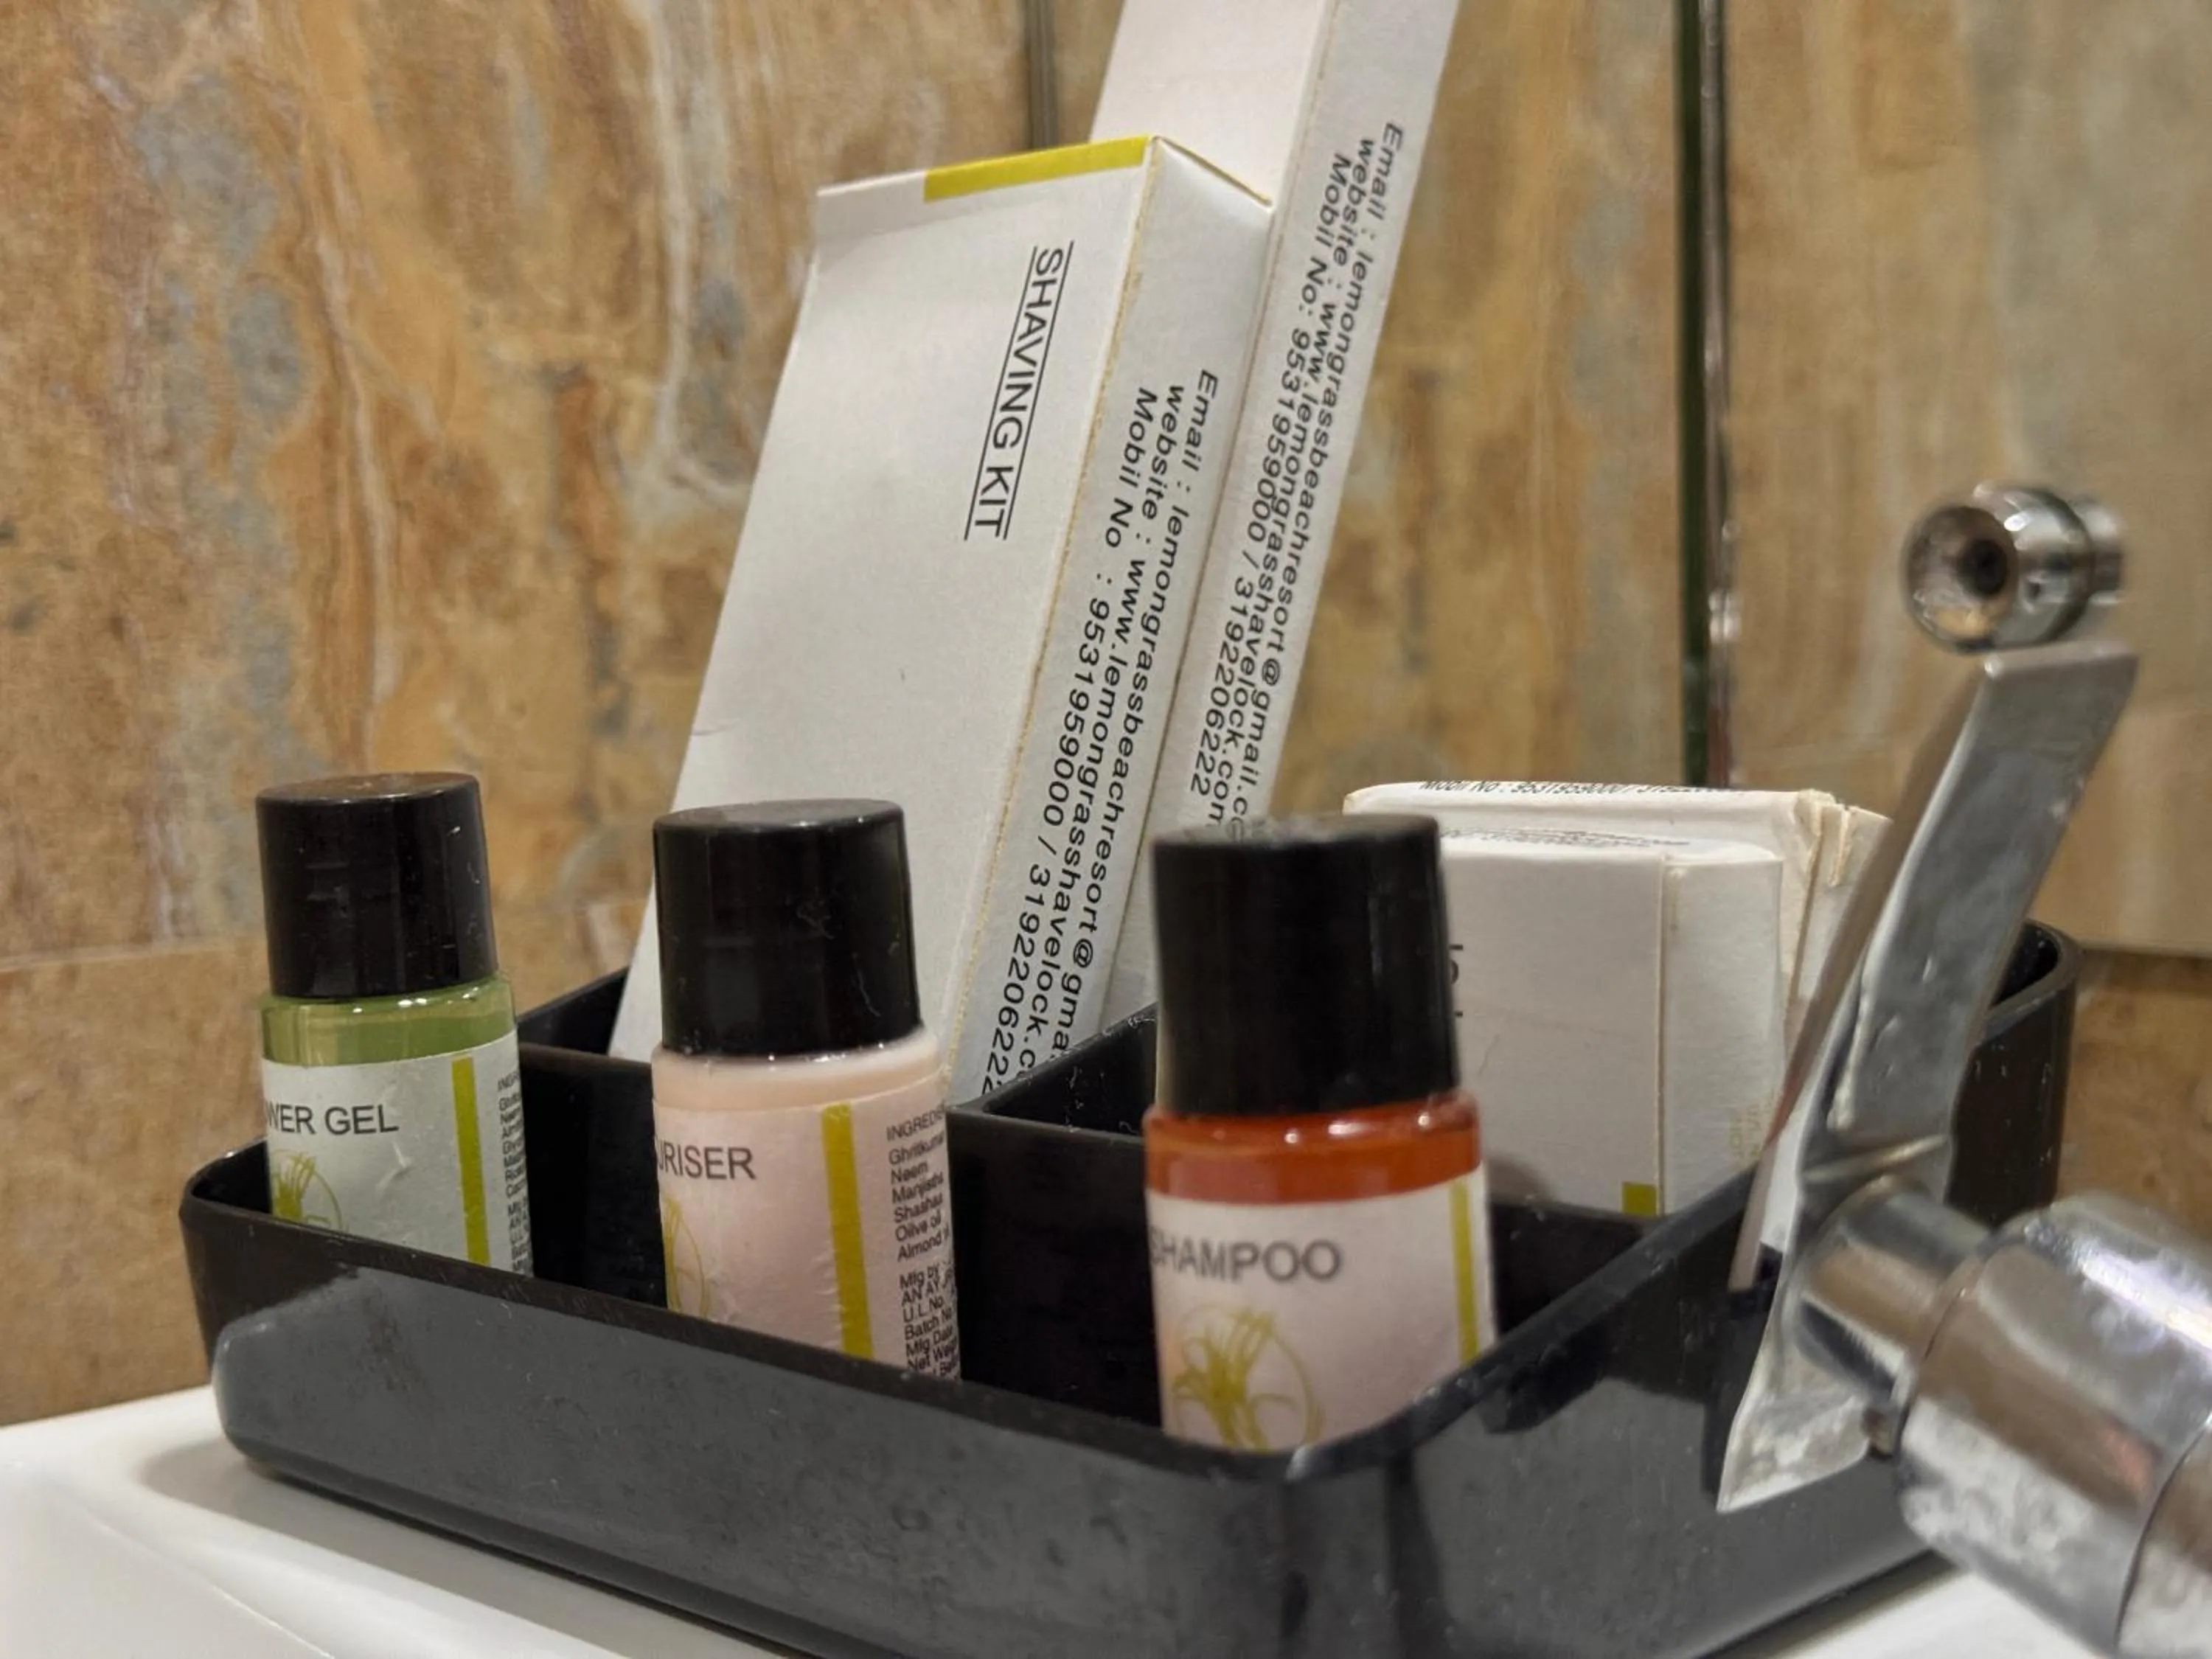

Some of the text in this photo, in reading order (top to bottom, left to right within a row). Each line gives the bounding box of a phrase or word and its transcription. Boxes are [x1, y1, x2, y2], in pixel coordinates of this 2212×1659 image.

[1315, 153, 1352, 248] Mobil
[1333, 139, 1374, 267] website
[1367, 122, 1404, 221] Email
[975, 247, 1062, 538] SHAVING KIT
[1119, 387, 1158, 488] Mobil
[1141, 385, 1184, 520] website
[1182, 369, 1219, 472] Email
[1248, 327, 1310, 542] 9531959000
[1105, 497, 1134, 548] No
[1043, 598, 1110, 827] 9531959000
[1191, 576, 1255, 796] 3192206222
[1018, 560, 1146, 1076] www.lemongrasshavelock.c
[1051, 505, 1190, 1059] lemongrassbeachresort@gma
[324, 1104, 400, 1135] GEL
